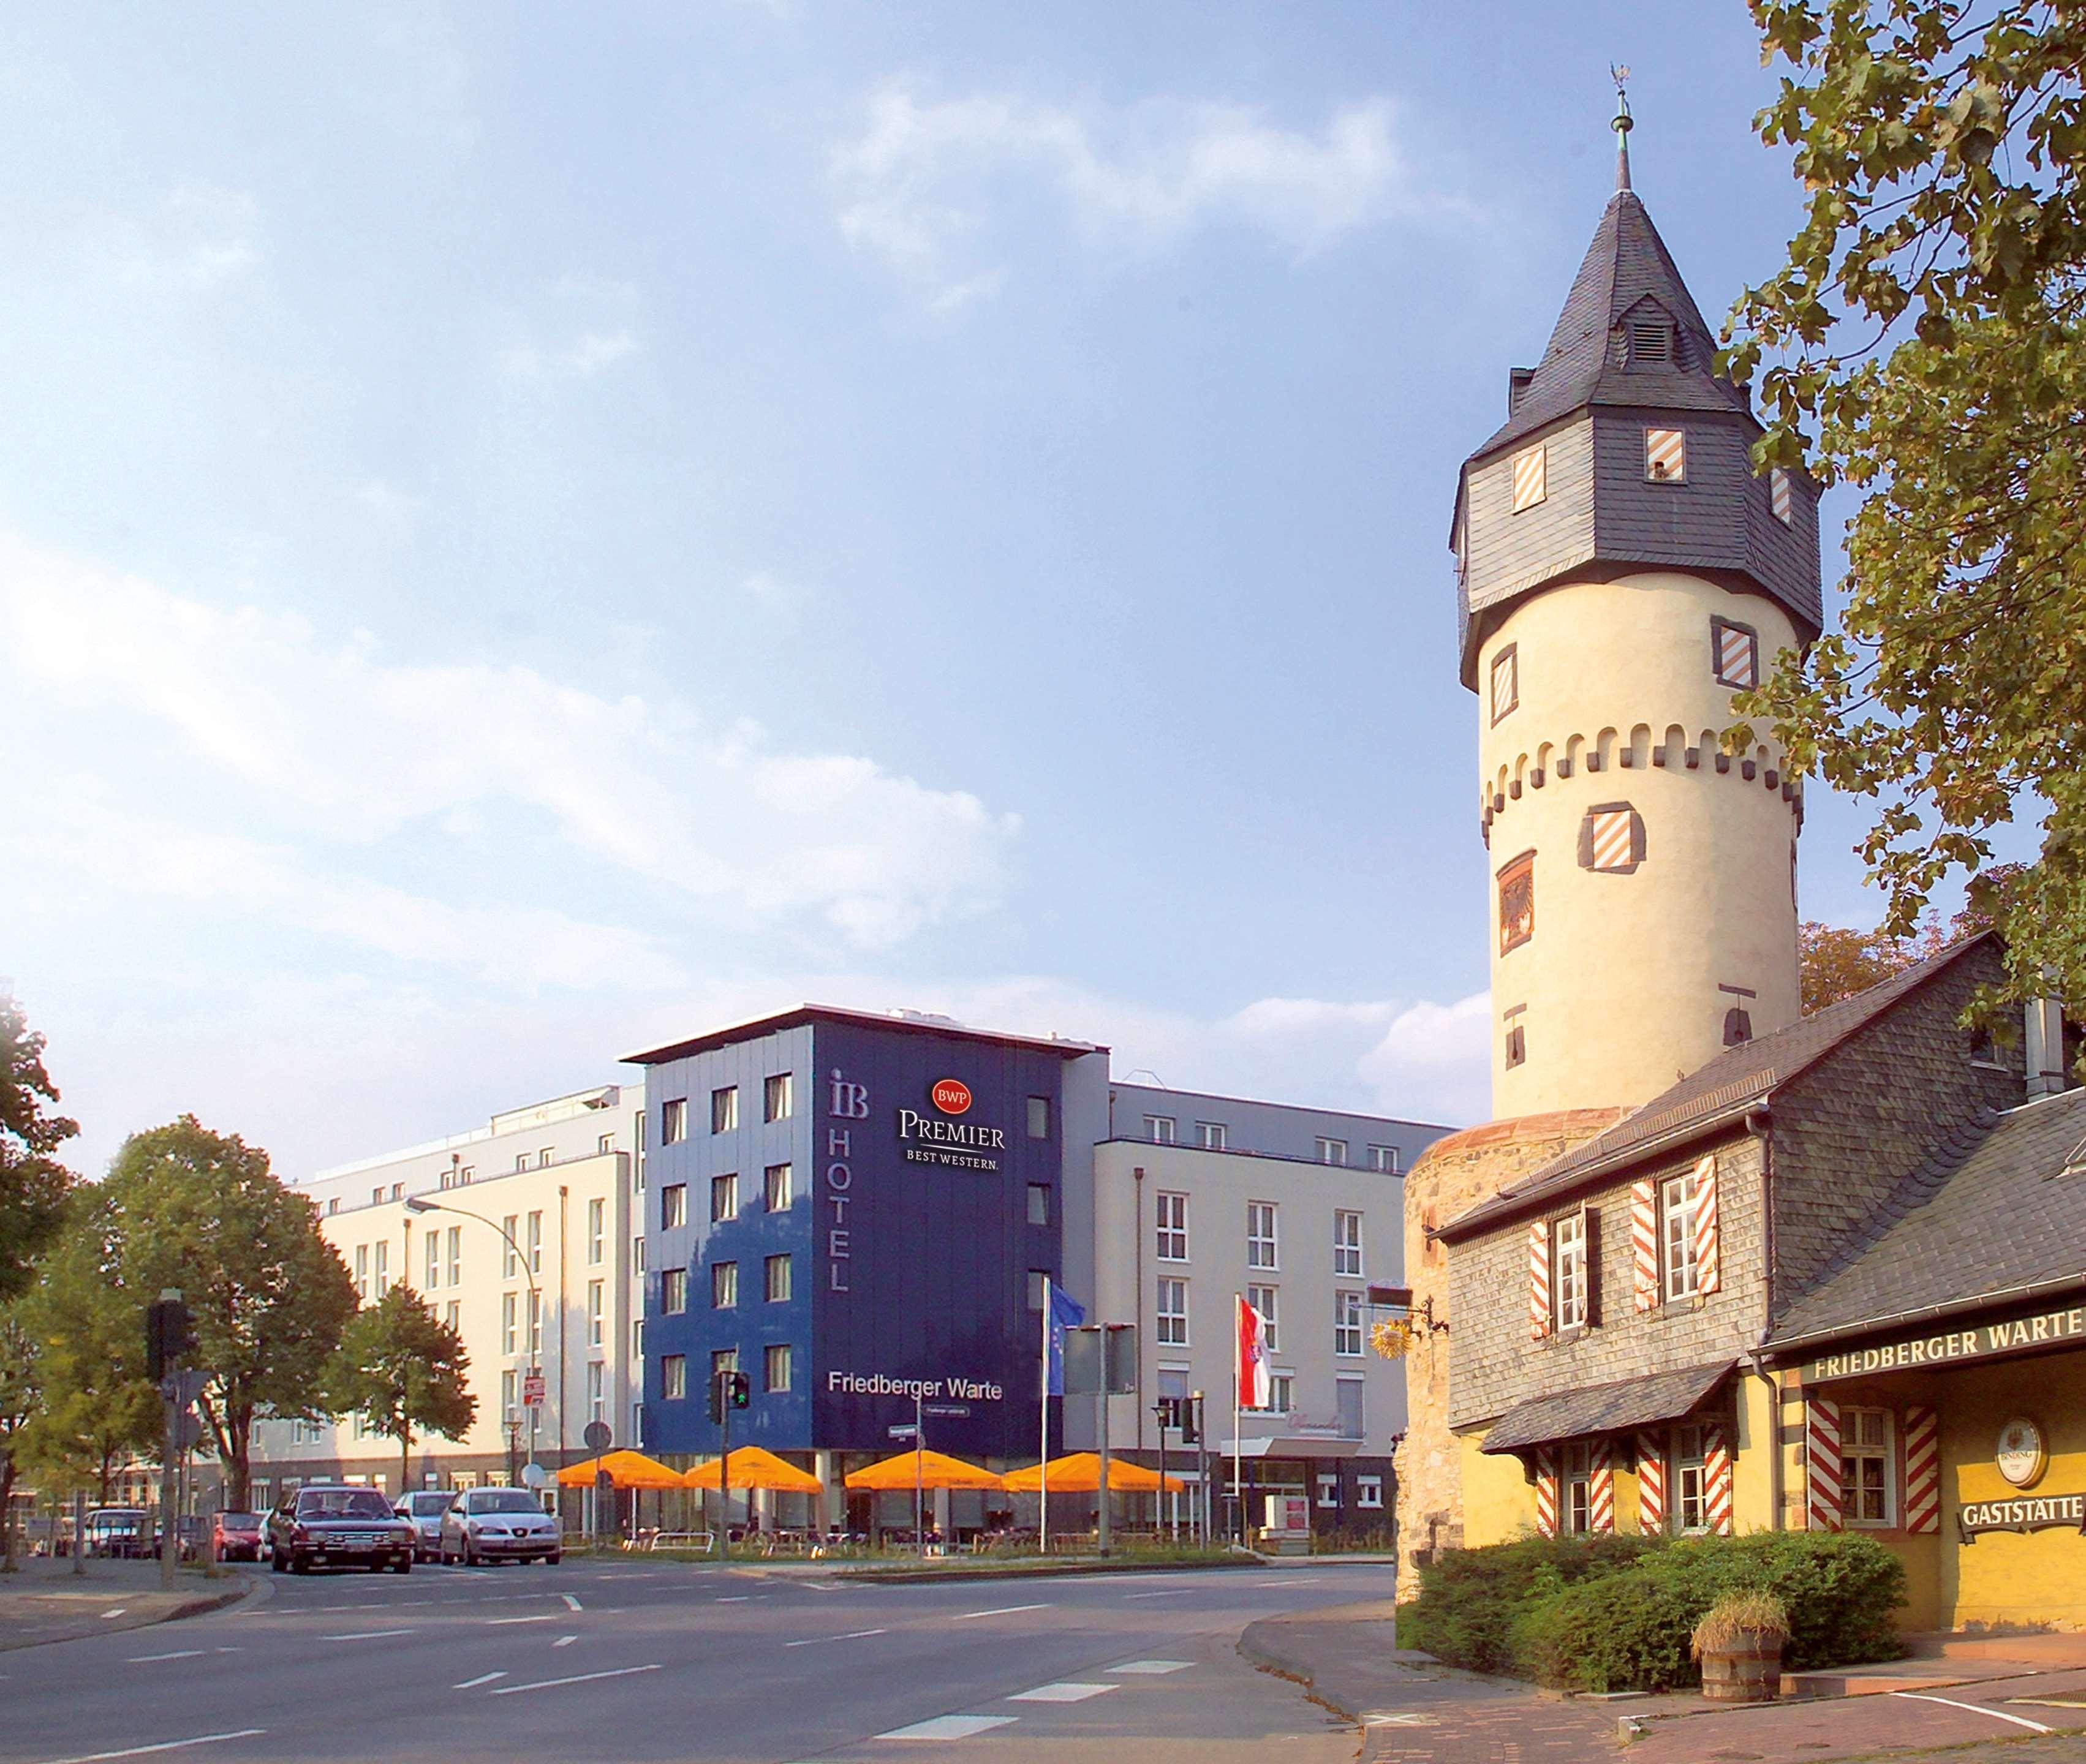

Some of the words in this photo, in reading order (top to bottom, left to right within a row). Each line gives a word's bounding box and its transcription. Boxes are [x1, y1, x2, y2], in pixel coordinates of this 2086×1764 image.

[939, 1089, 967, 1104] BWP
[899, 1109, 1005, 1149] PREMIER
[907, 1149, 937, 1163] BEST
[828, 1128, 852, 1292] HOTEL
[1815, 1330, 1978, 1379] FRIEDBERGER
[1987, 1308, 2084, 1349] WARTE
[828, 1371, 943, 1400] Friedberger
[947, 1377, 1003, 1400] Warte
[1963, 1496, 2083, 1526] GASTSTÄTTE
